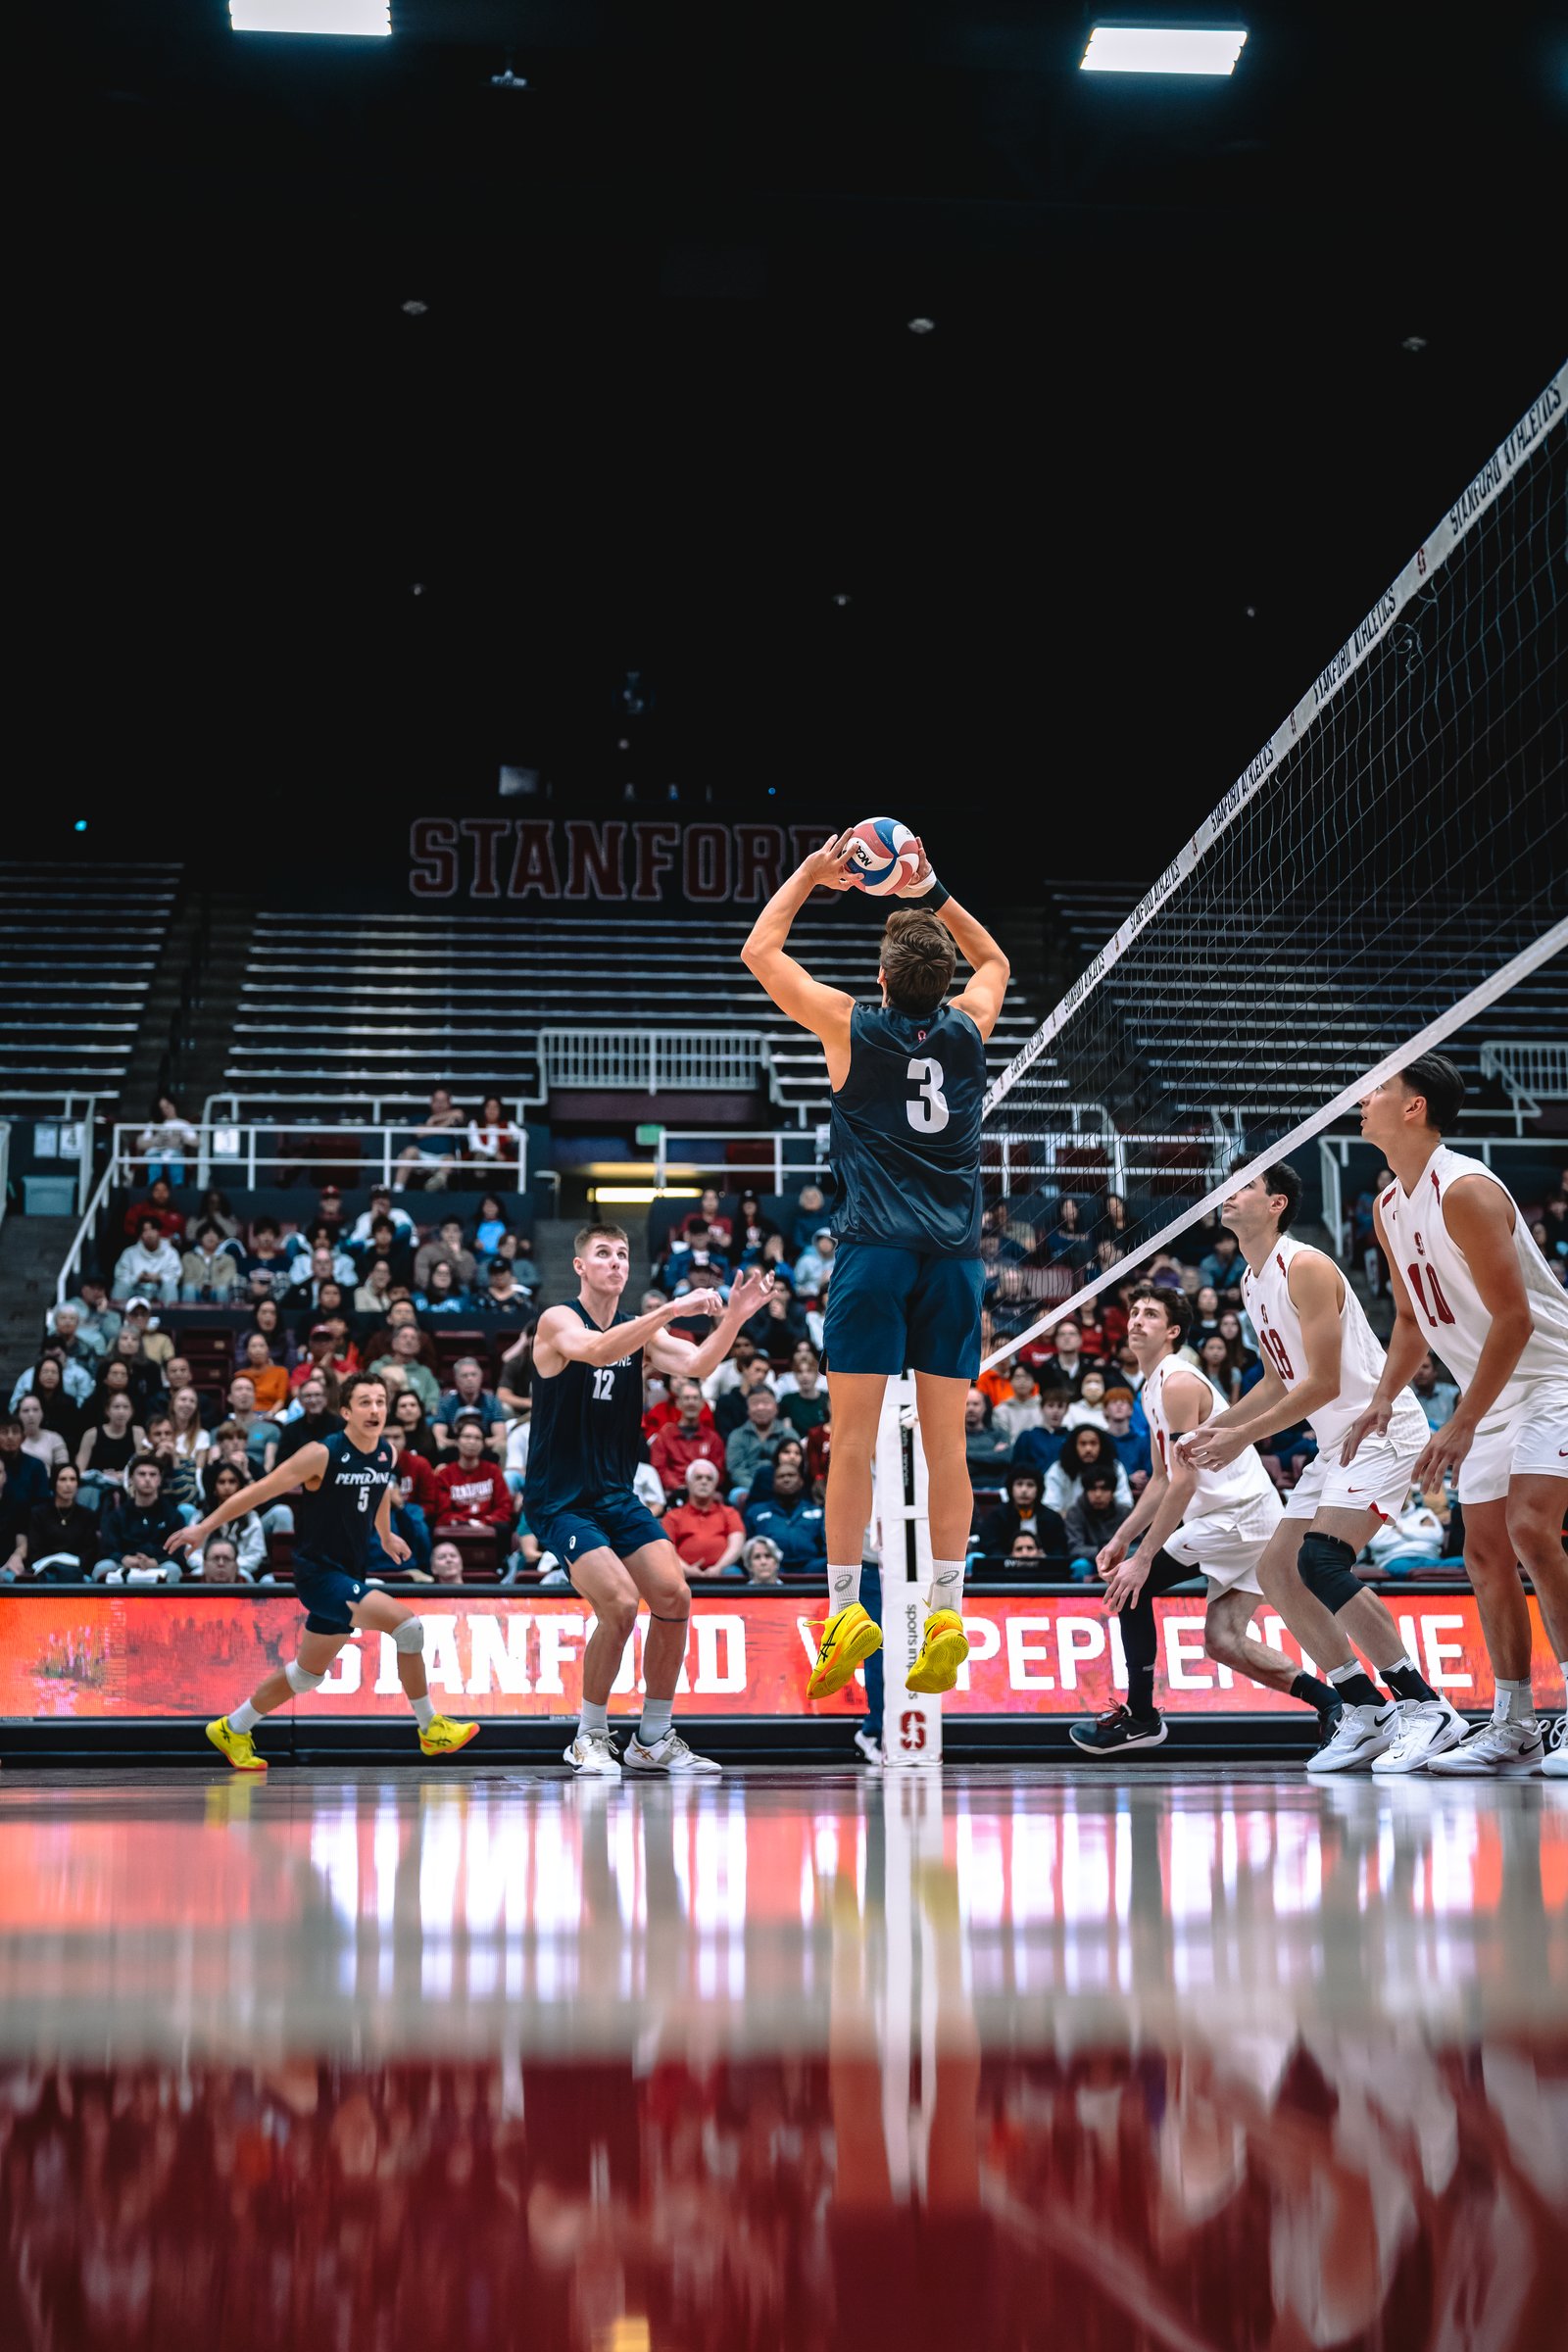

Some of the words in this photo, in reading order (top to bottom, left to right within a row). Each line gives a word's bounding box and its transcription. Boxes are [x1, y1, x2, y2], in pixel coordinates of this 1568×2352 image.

[1448, 454, 1502, 536] STANFORD
[855, 841, 872, 867] NCA
[906, 1056, 950, 1134] 3
[1407, 1261, 1456, 1328] 10
[1260, 1328, 1295, 1380] 18
[592, 1368, 615, 1401] 12
[357, 1486, 370, 1513] 5
[905, 1603, 918, 1646] sports
